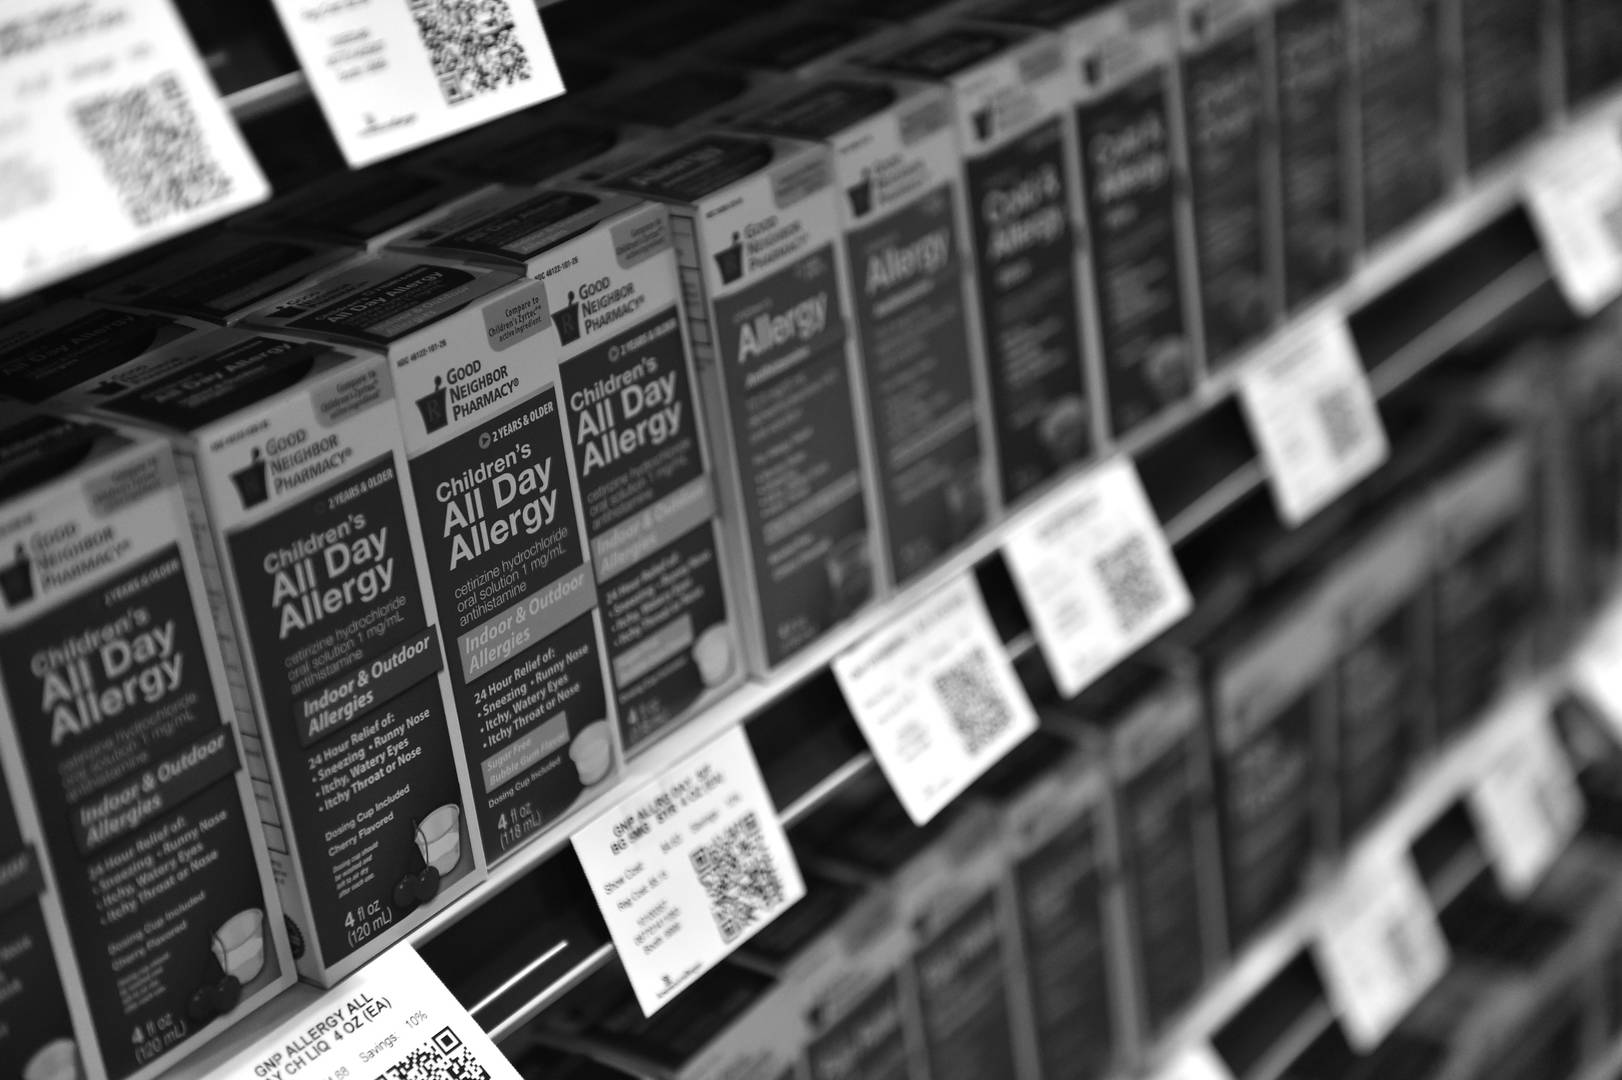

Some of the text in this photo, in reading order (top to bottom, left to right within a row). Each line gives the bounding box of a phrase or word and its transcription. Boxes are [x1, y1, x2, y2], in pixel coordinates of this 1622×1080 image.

[579, 276, 610, 300] GOOD
[582, 283, 635, 318] NEIGHBOR
[737, 291, 829, 364] Allergy
[446, 360, 482, 386] GOOD
[450, 365, 509, 404] NEIGHBOR
[570, 356, 659, 413] Children's
[491, 401, 555, 443] 2 YEARS & OLDER
[577, 370, 677, 446] All Day
[266, 428, 307, 456] GOOD
[271, 434, 340, 476] NEIGHBOR
[583, 401, 683, 477] Allergy
[367, 468, 394, 489] OLDER
[435, 443, 533, 504] Children's
[443, 487, 486, 538] All
[493, 456, 552, 510] Day
[263, 512, 367, 574] Children's
[449, 488, 558, 572] Allergy
[272, 526, 388, 608] All Day
[454, 526, 569, 599] cetirizine hydrochloride
[457, 595, 479, 613] oral
[479, 570, 520, 600] solution
[279, 556, 394, 640] Allergy
[459, 581, 528, 627] antihistamine
[465, 614, 514, 654] Indoor
[515, 606, 527, 625] &
[529, 573, 586, 616] Outdoor
[41, 618, 176, 716] All Day
[303, 636, 430, 718] Indoor & Outdoor
[469, 627, 531, 675] Allergies
[50, 650, 185, 749] Allergy
[473, 689, 487, 705] 24
[488, 675, 513, 695] Hour
[513, 658, 542, 680] Relief
[482, 684, 528, 719] Sneezing
[535, 659, 566, 684] Runny
[485, 674, 570, 733] Itchy, Watery Eyes
[308, 689, 374, 737] Allergies
[308, 712, 396, 771] 24 Hour Relief of:
[488, 727, 514, 748] Itchy
[513, 705, 546, 731] Throat
[545, 697, 556, 710] or
[317, 708, 431, 782] Sneezing Runny Nose
[350, 751, 387, 779] Watery
[387, 738, 411, 757] Eyes
[80, 782, 140, 827] Indoor
[156, 733, 227, 784] Outdoor
[324, 745, 423, 811] Itchy Throat or Nose
[356, 807, 376, 824] Cup
[375, 784, 411, 812] Included
[86, 793, 163, 849] Allergies
[498, 811, 508, 831] 4
[344, 911, 355, 929] 4
[367, 899, 382, 916] oz
[347, 905, 394, 950] (120 mL)
[254, 992, 375, 1079] GNP ALLERGY ALL
[284, 1055, 308, 1077] CH
[305, 1040, 332, 1064] LIQ
[333, 1029, 344, 1043] 4
[343, 1015, 365, 1035] OZ
[363, 996, 393, 1025] (EA)
[358, 1009, 430, 1065] Savings: 10%
